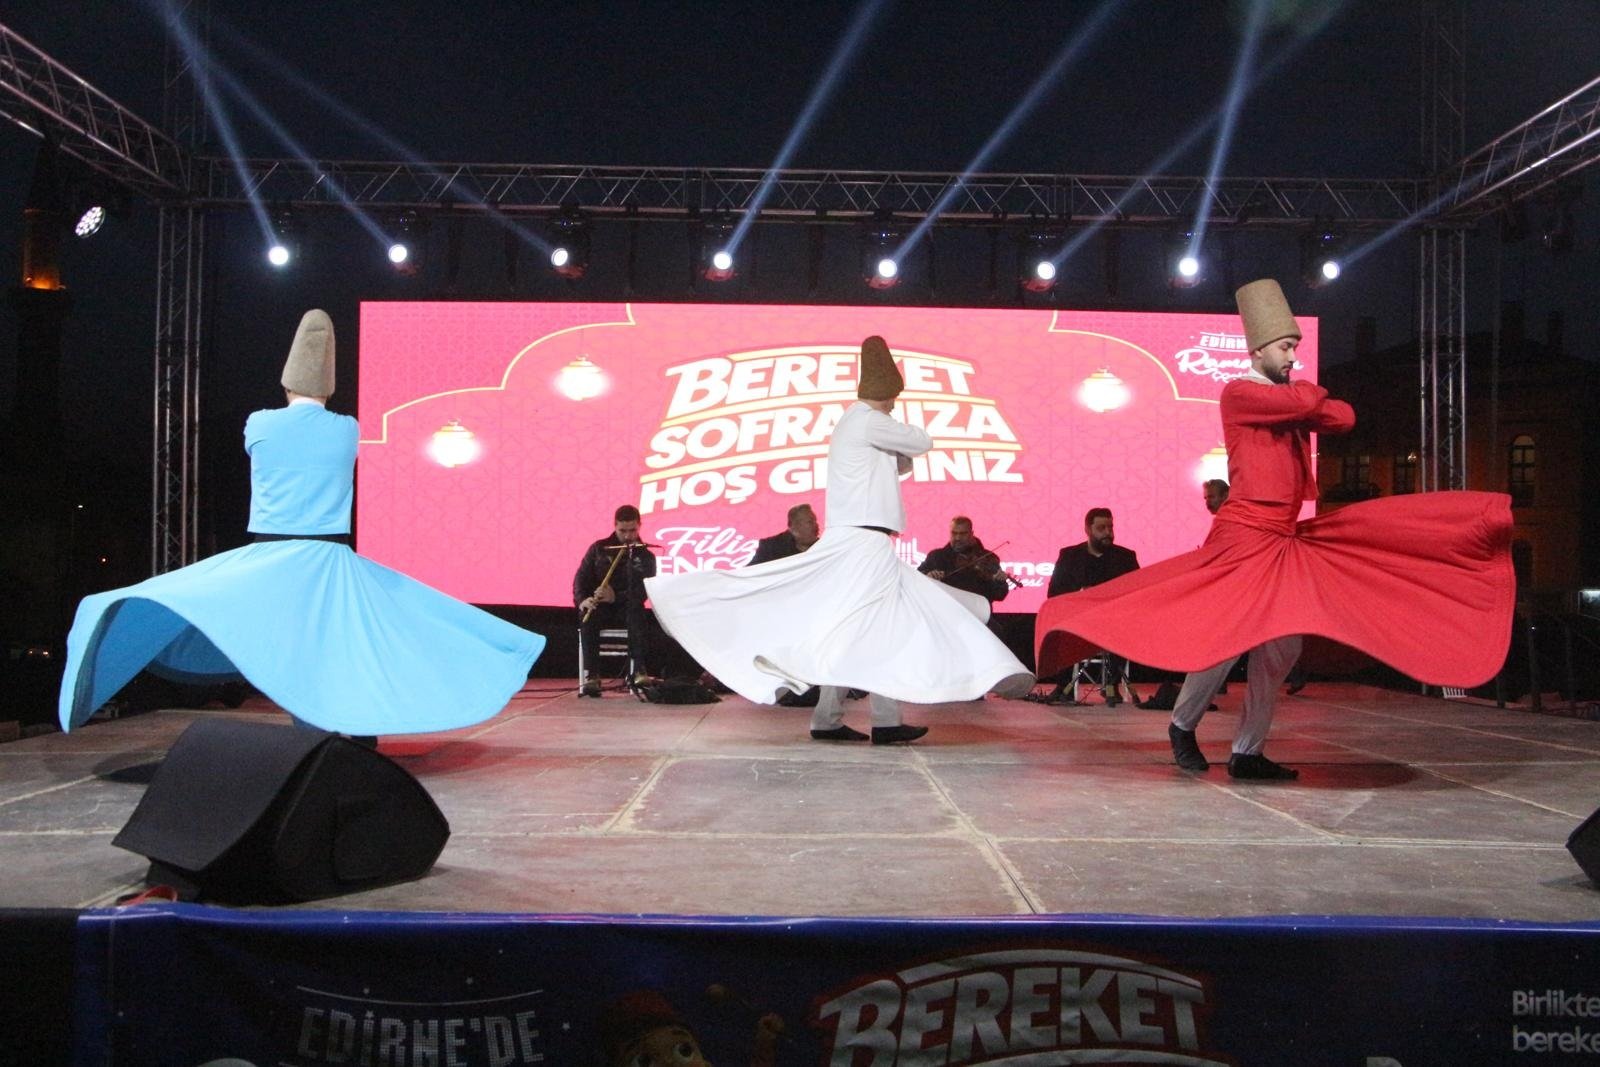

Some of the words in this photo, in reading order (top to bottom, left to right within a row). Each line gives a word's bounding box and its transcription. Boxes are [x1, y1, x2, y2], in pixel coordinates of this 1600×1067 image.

[665, 354, 975, 418] BEREET
[645, 401, 1017, 469] SOFRAIZA
[639, 465, 757, 515] HOŞ
[655, 526, 759, 568] Filiz
[819, 966, 1204, 1067] BEREKET
